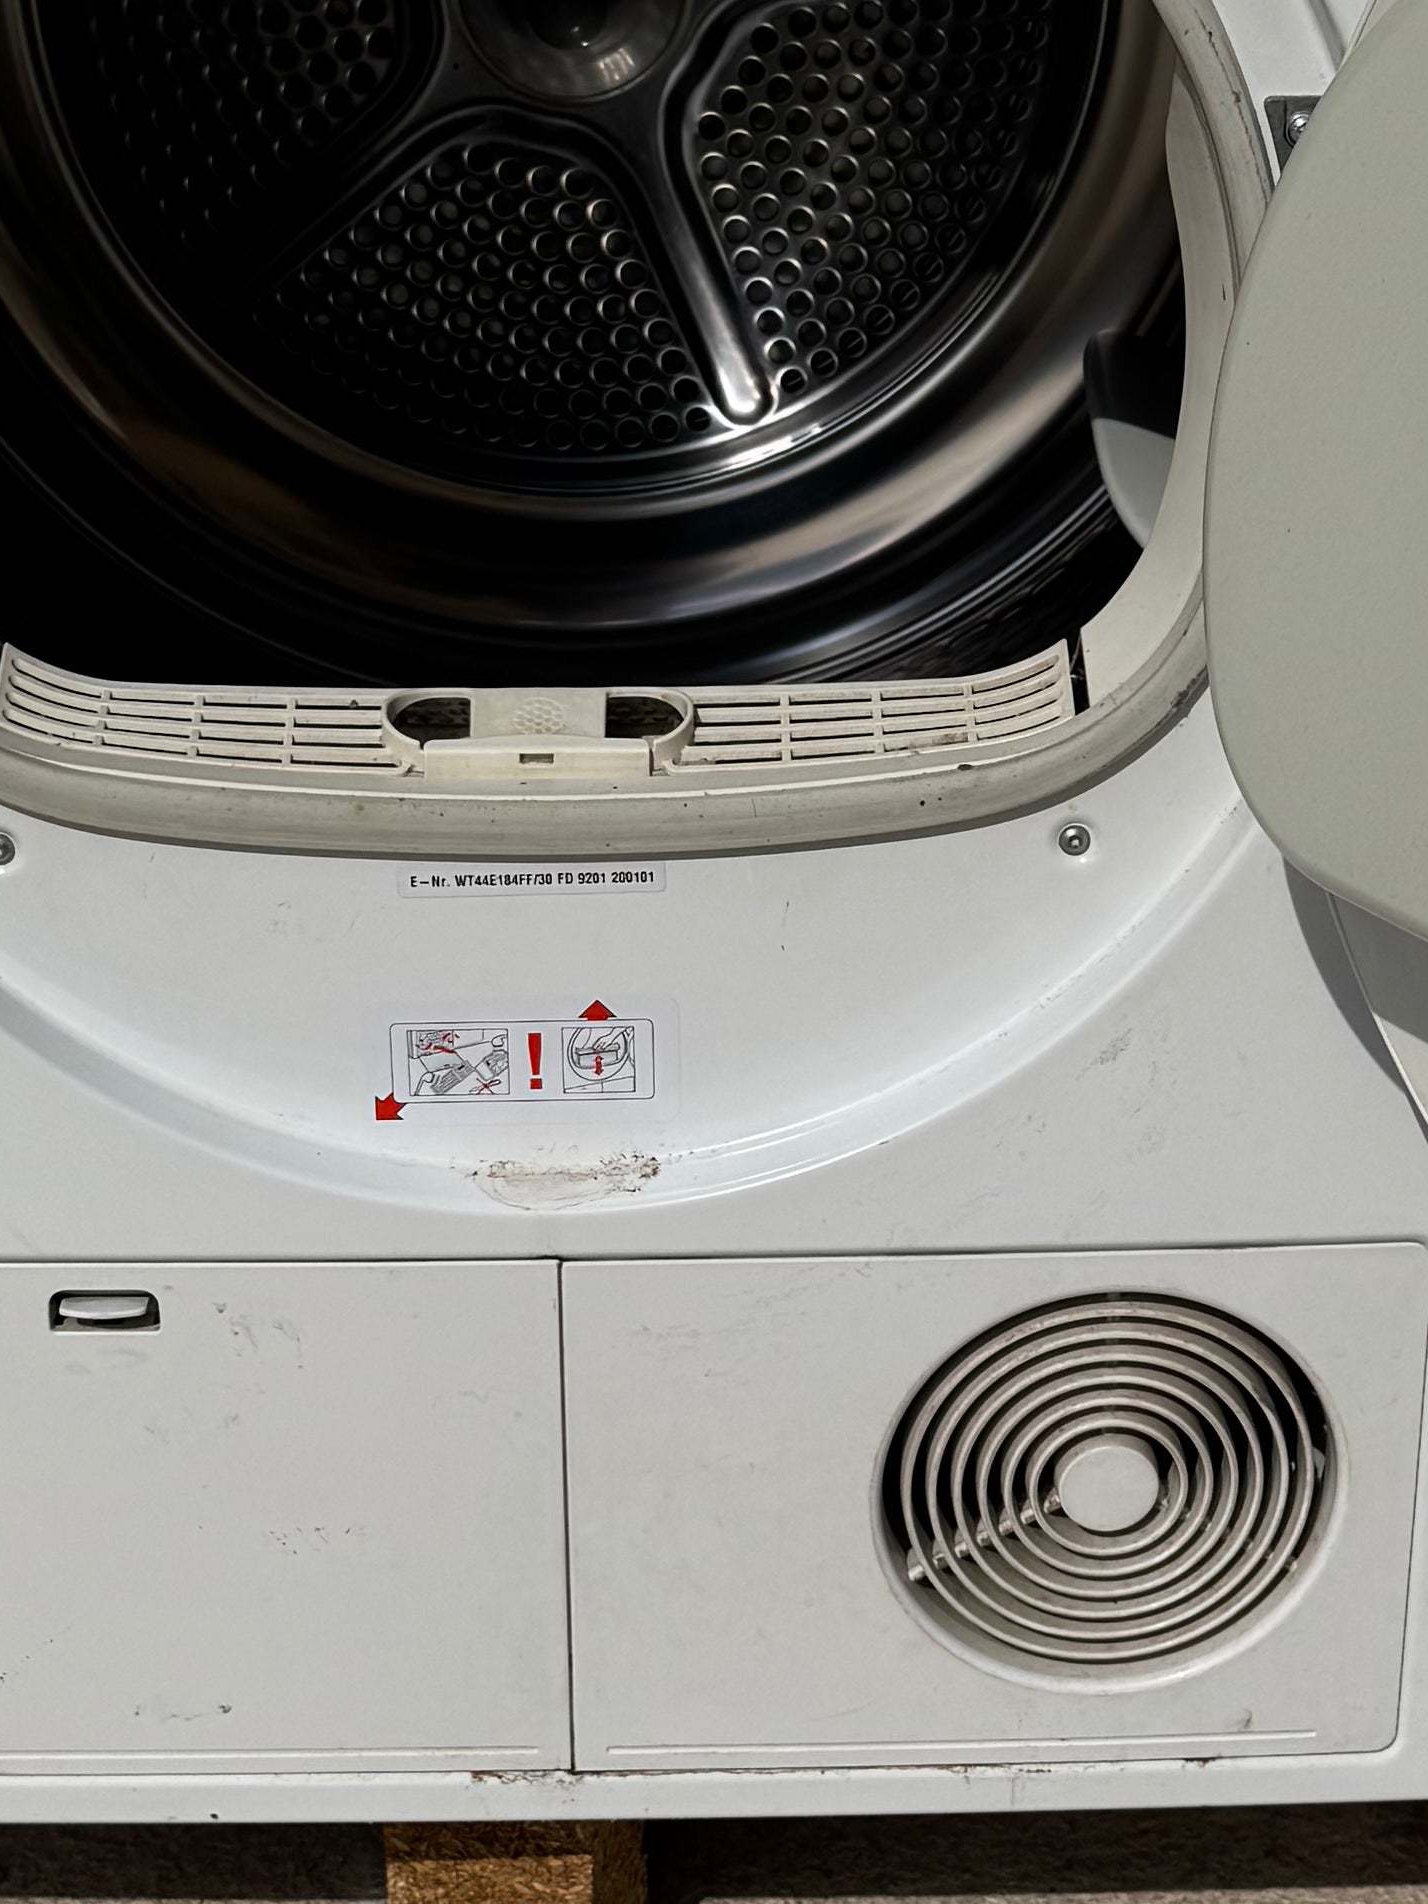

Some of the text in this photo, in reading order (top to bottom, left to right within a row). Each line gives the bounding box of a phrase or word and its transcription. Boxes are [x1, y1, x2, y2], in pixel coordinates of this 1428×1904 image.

[557, 872, 574, 885] FD
[577, 871, 606, 885] 9201
[610, 870, 654, 884] 200101
